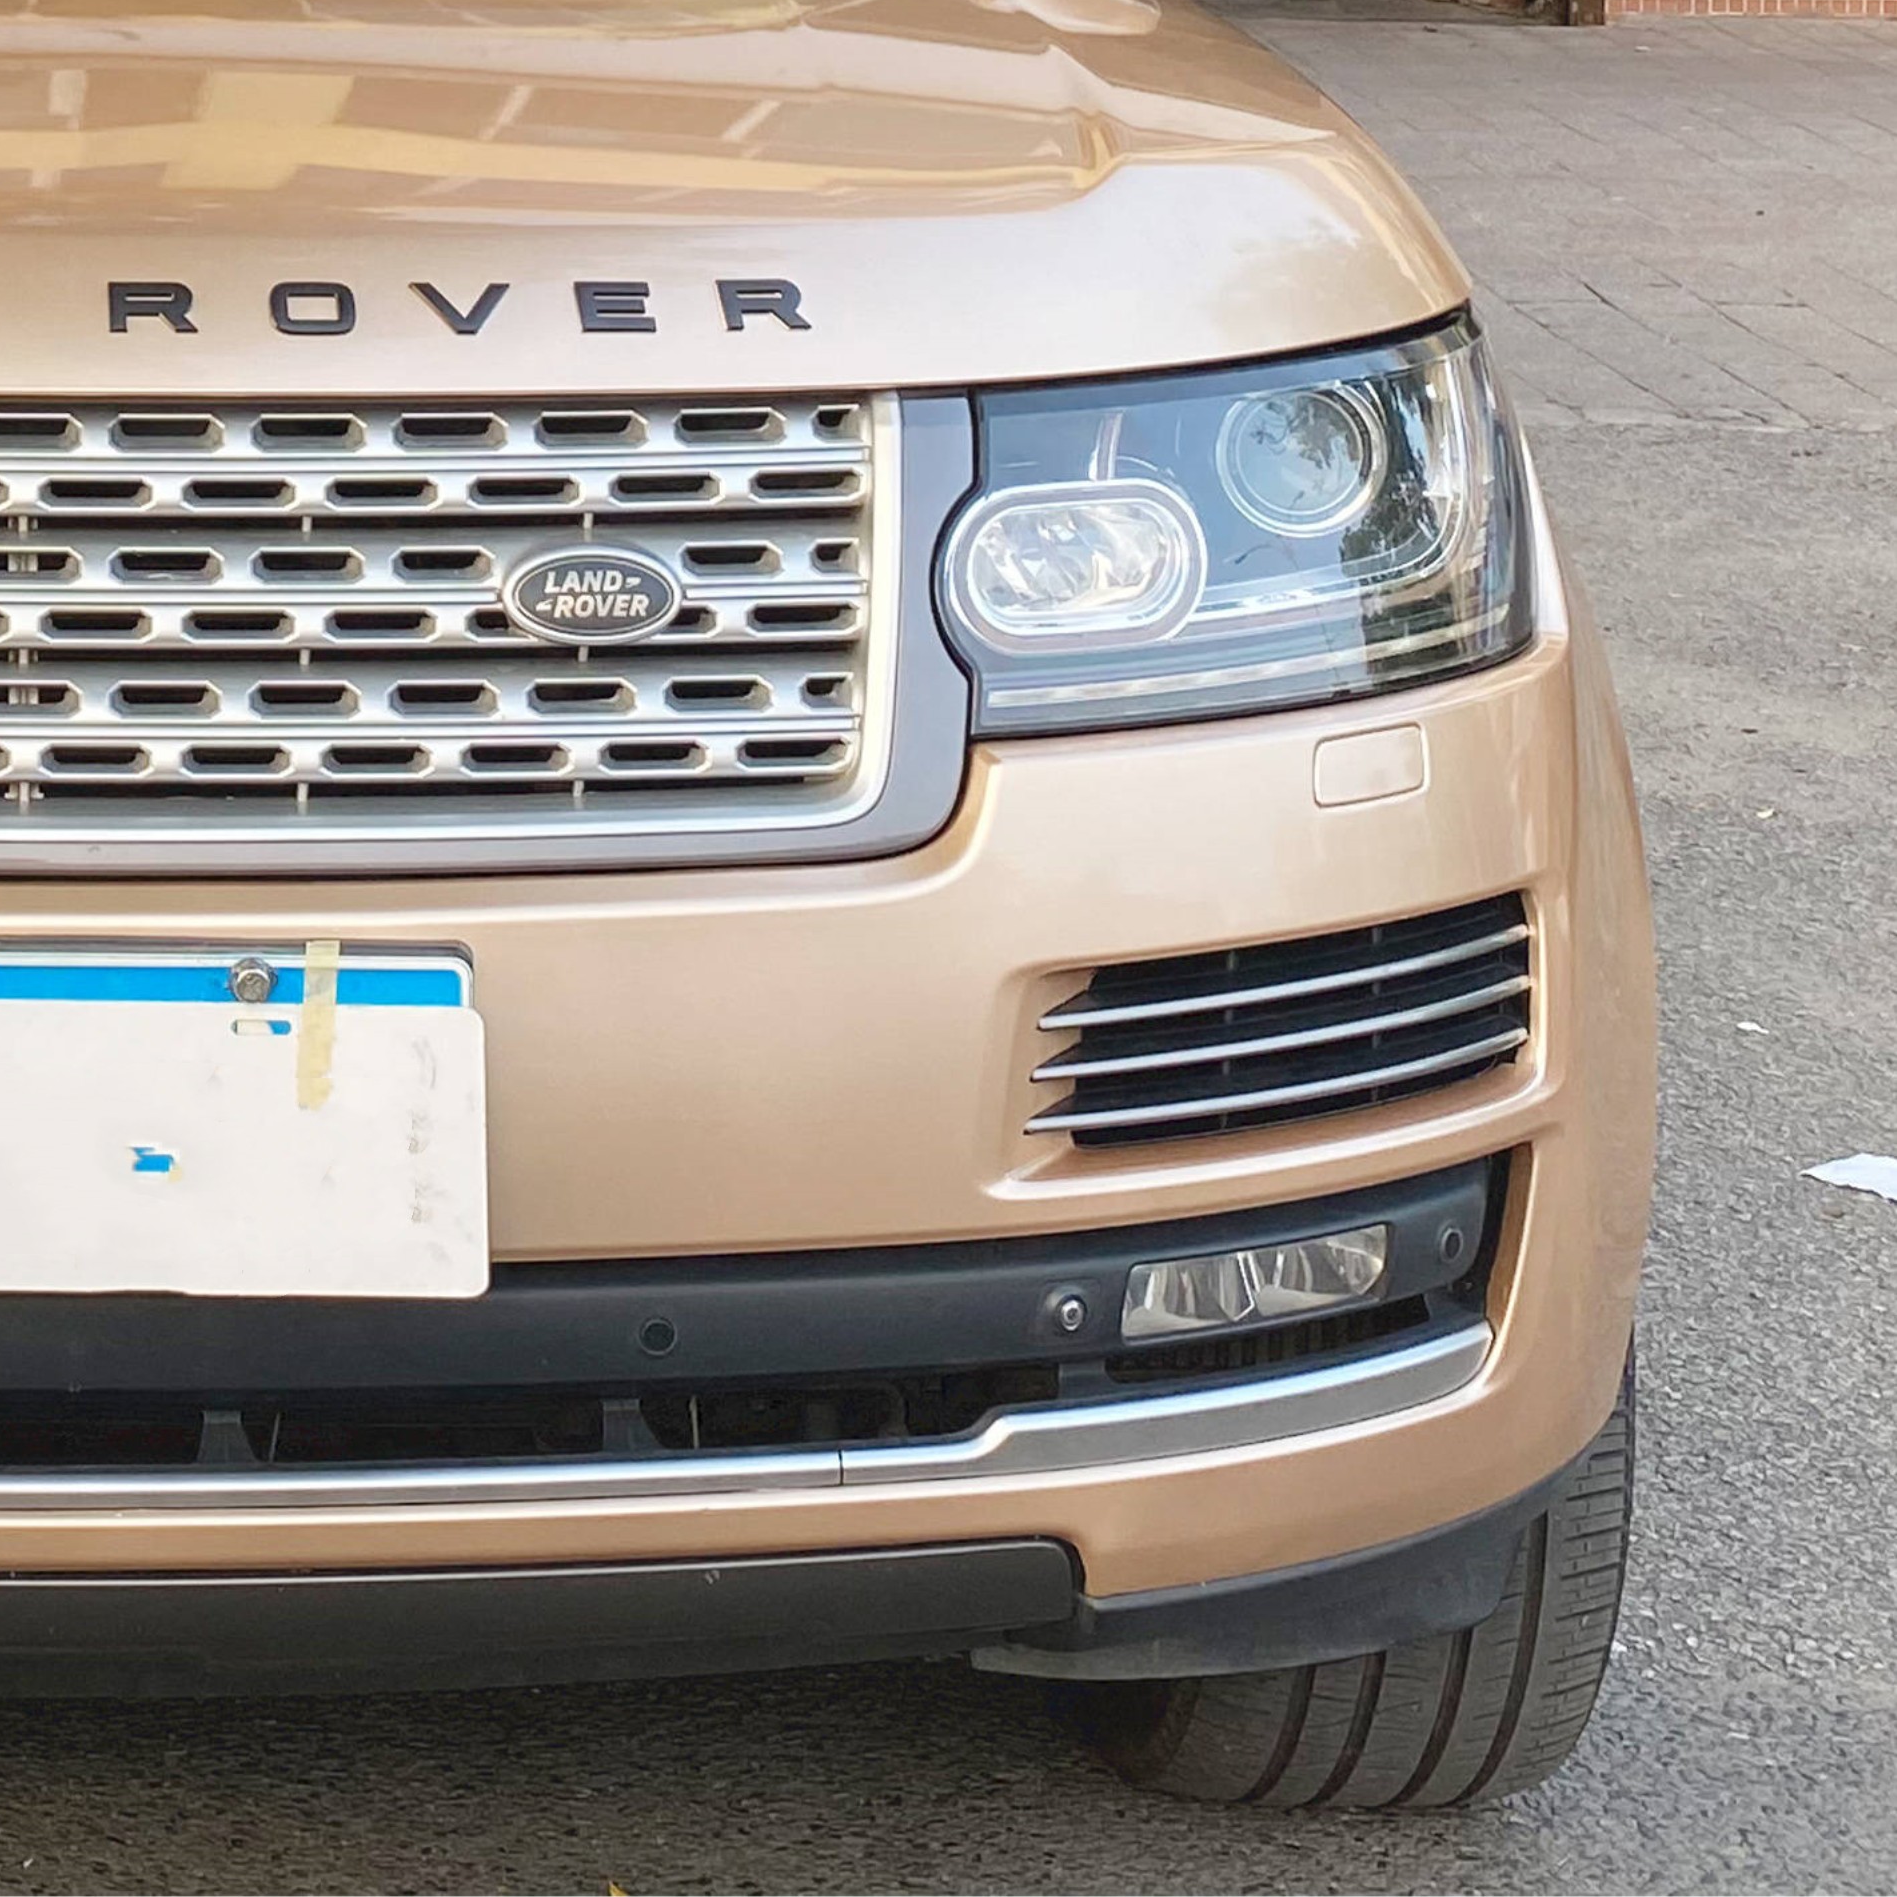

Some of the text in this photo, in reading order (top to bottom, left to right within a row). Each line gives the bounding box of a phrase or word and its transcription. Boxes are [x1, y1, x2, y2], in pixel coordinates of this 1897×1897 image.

[109, 279, 812, 335] ROVER
[544, 570, 623, 594] LAND
[553, 594, 650, 618] ROVER
